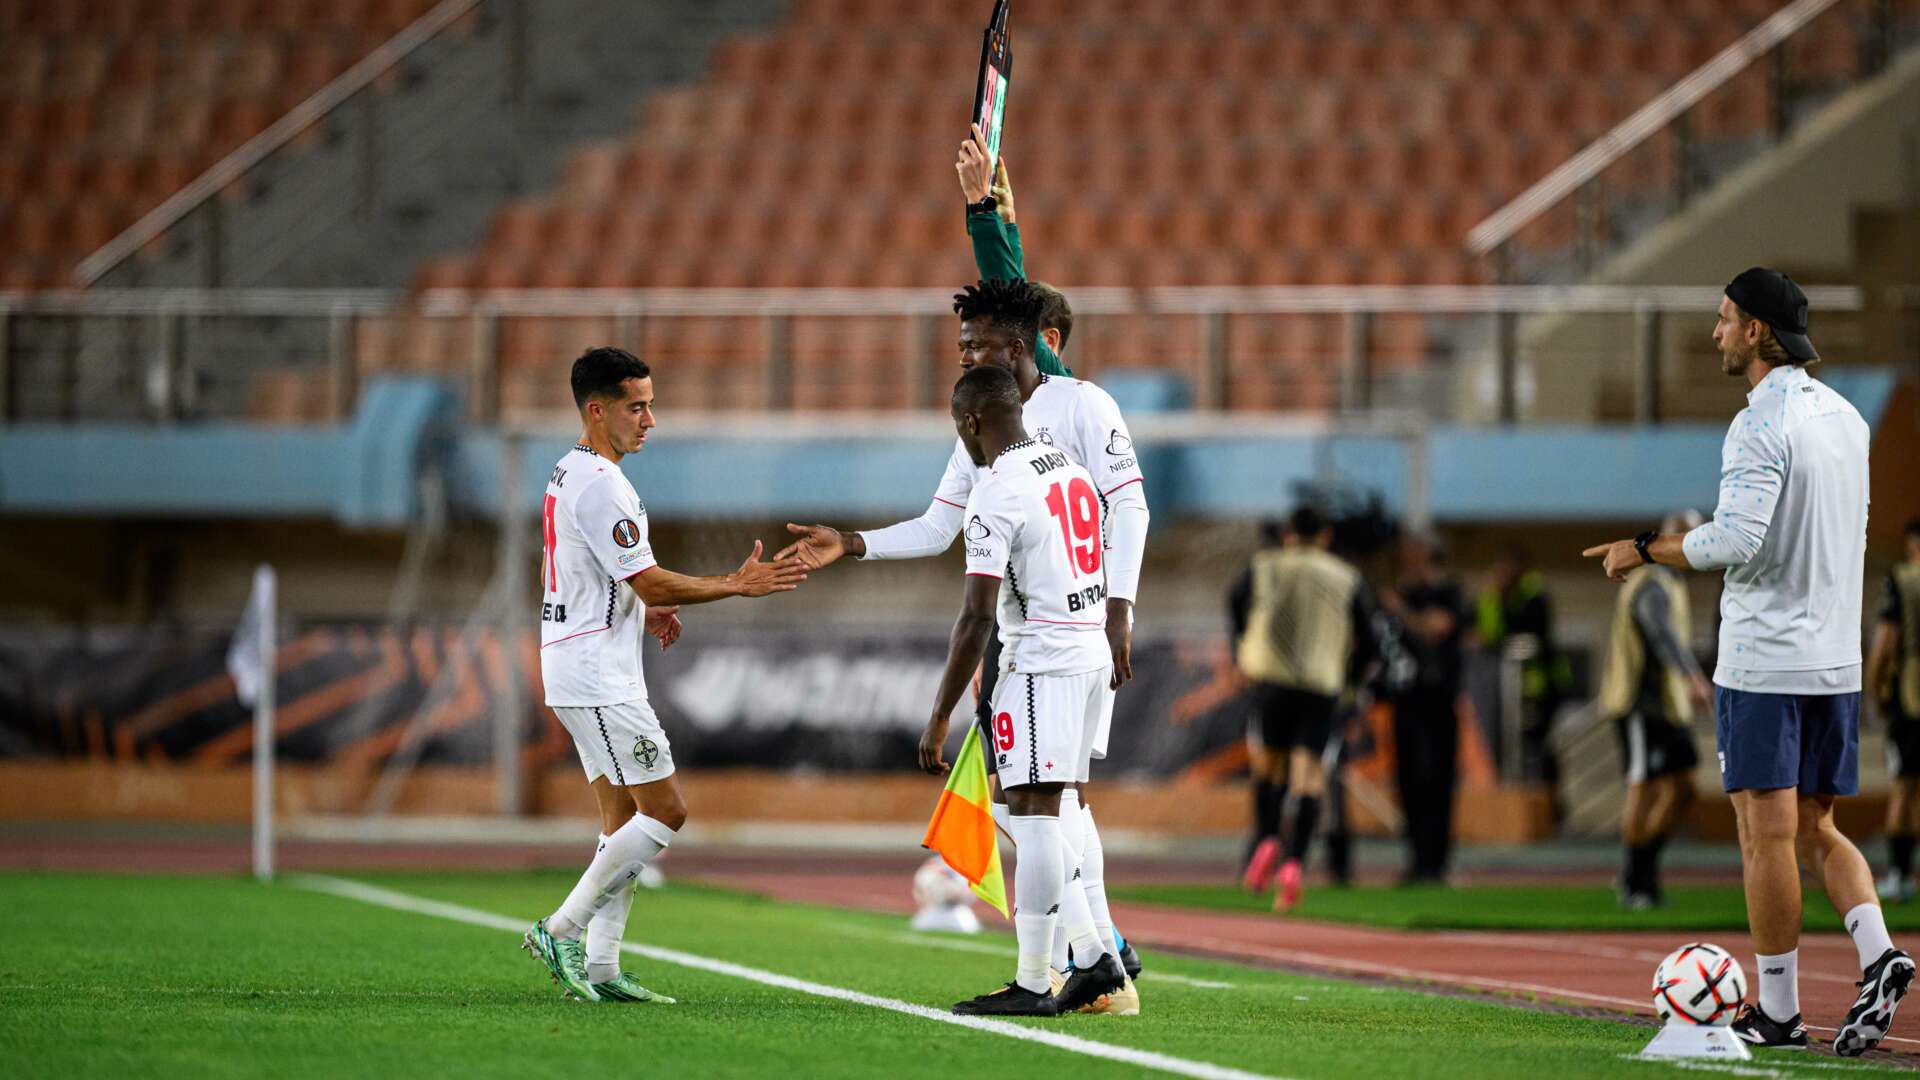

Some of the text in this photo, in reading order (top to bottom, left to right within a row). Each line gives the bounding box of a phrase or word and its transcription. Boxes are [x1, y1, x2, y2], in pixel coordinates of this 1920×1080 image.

[1029, 451, 1070, 475] DIABY
[1045, 477, 1101, 579] 19
[992, 712, 1015, 753] 19
